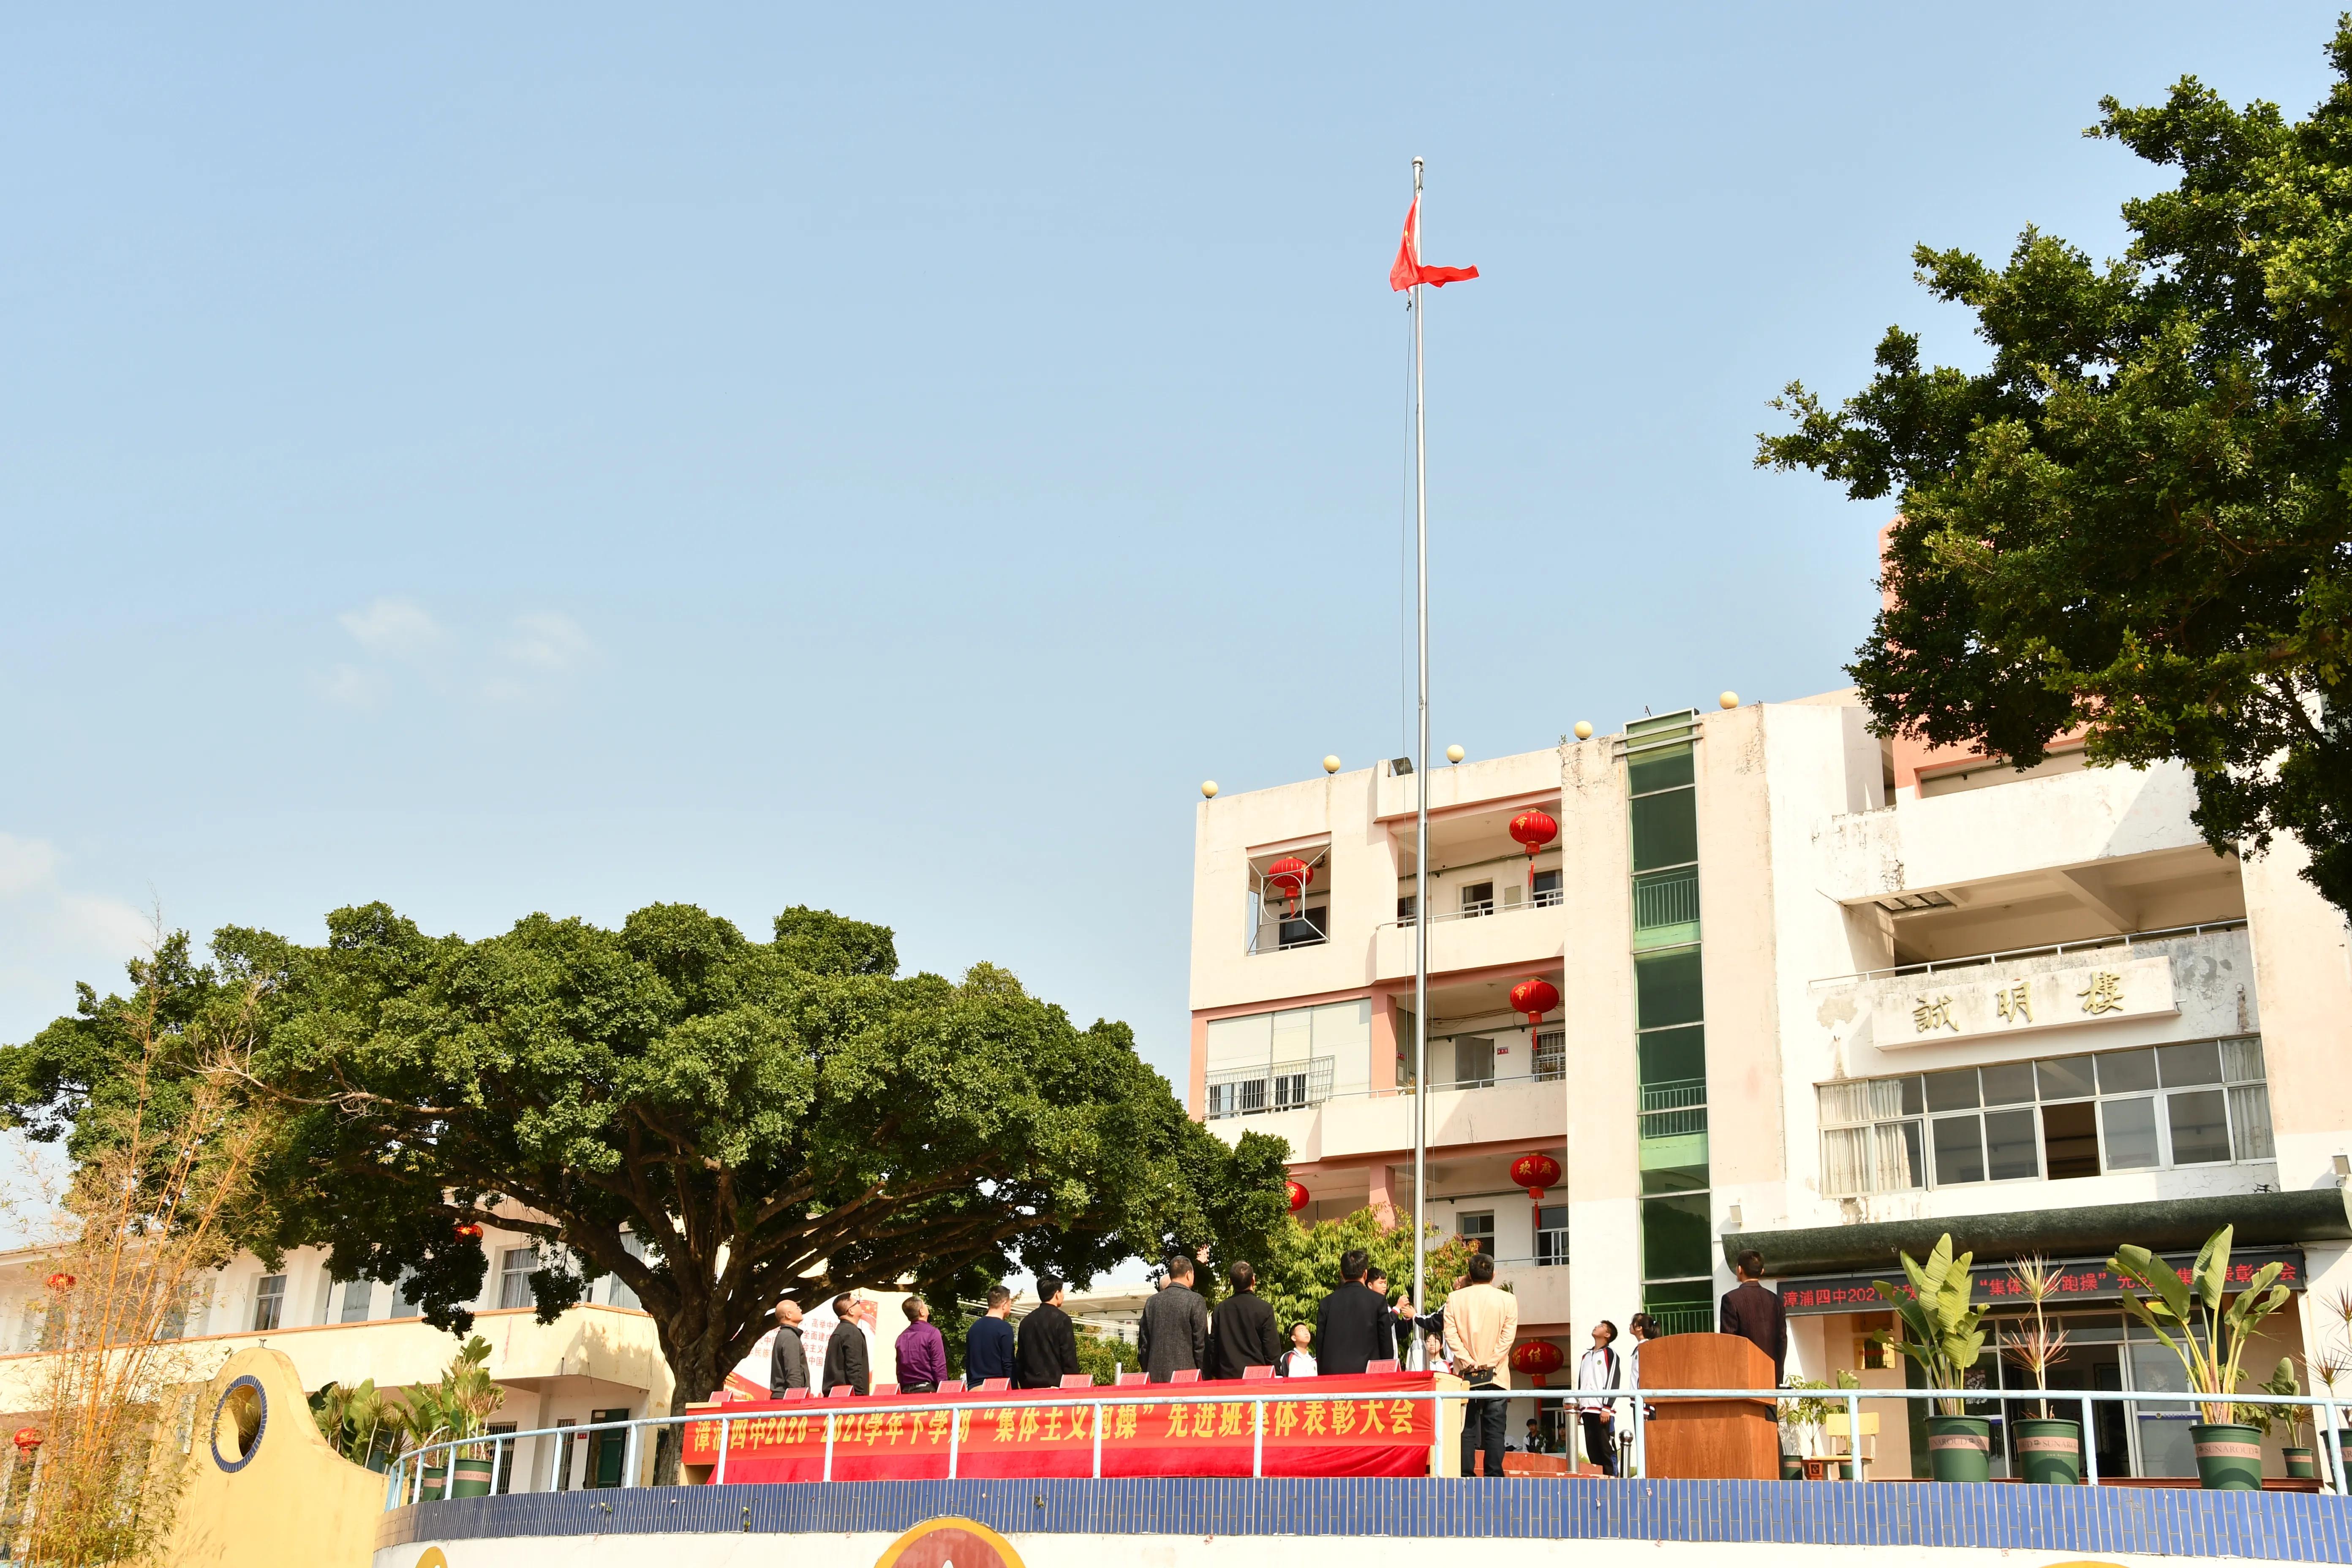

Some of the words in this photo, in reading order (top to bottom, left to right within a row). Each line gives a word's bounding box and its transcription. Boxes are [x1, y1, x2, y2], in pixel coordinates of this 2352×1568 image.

[1912, 971, 2125, 1032] 誠明樓
[803, 1342, 828, 1354] 会主义
[2204, 1446, 2254, 1454] SUNAROUD
